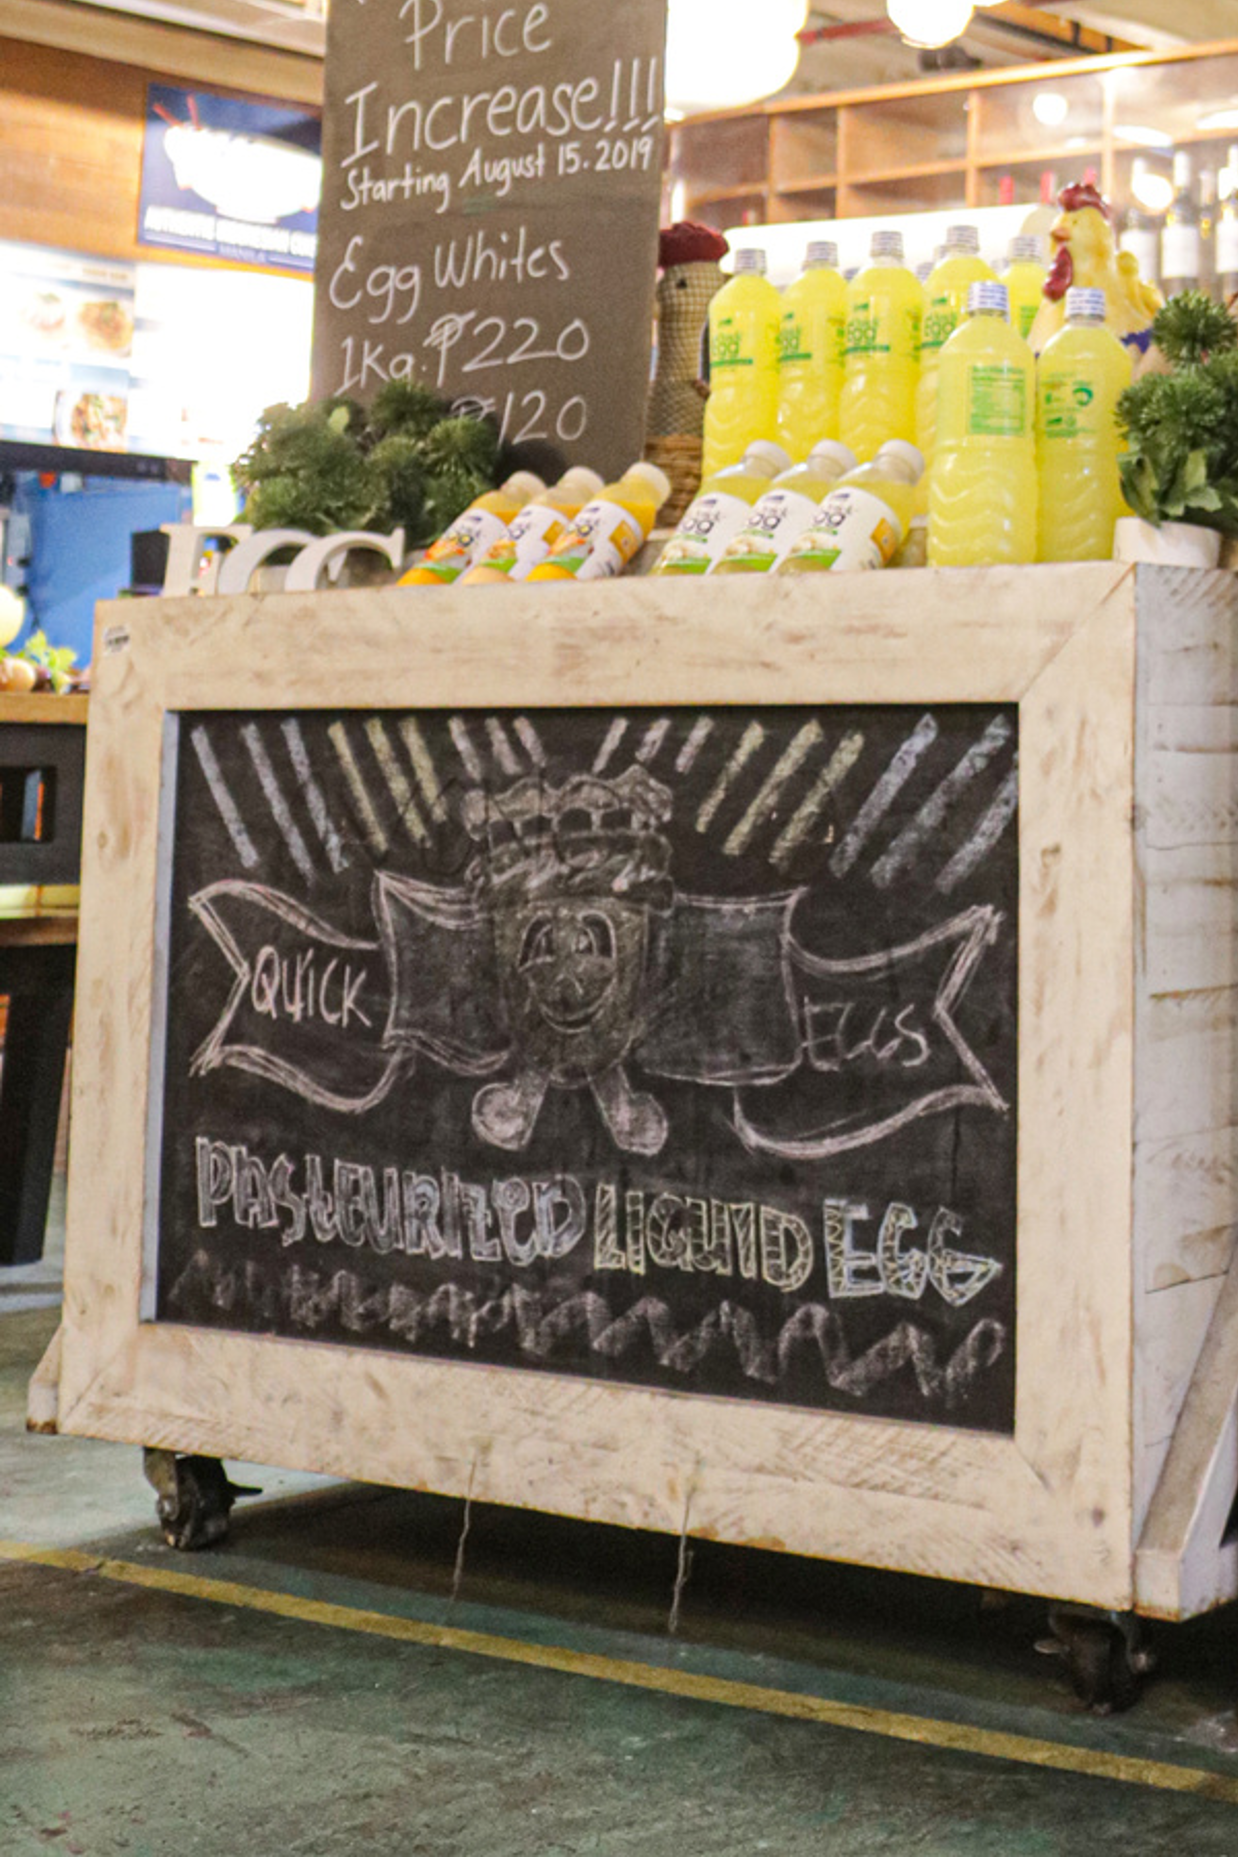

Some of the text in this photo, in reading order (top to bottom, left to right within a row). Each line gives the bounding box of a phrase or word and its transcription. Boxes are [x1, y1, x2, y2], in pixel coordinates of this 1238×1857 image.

[340, 56, 660, 168] Increase!!!
[340, 161, 451, 215] Starting
[458, 143, 546, 197] August
[329, 225, 571, 325] Egg Whites
[593, 1182, 815, 1293] LIQUID
[822, 1197, 1003, 1307] EGG
